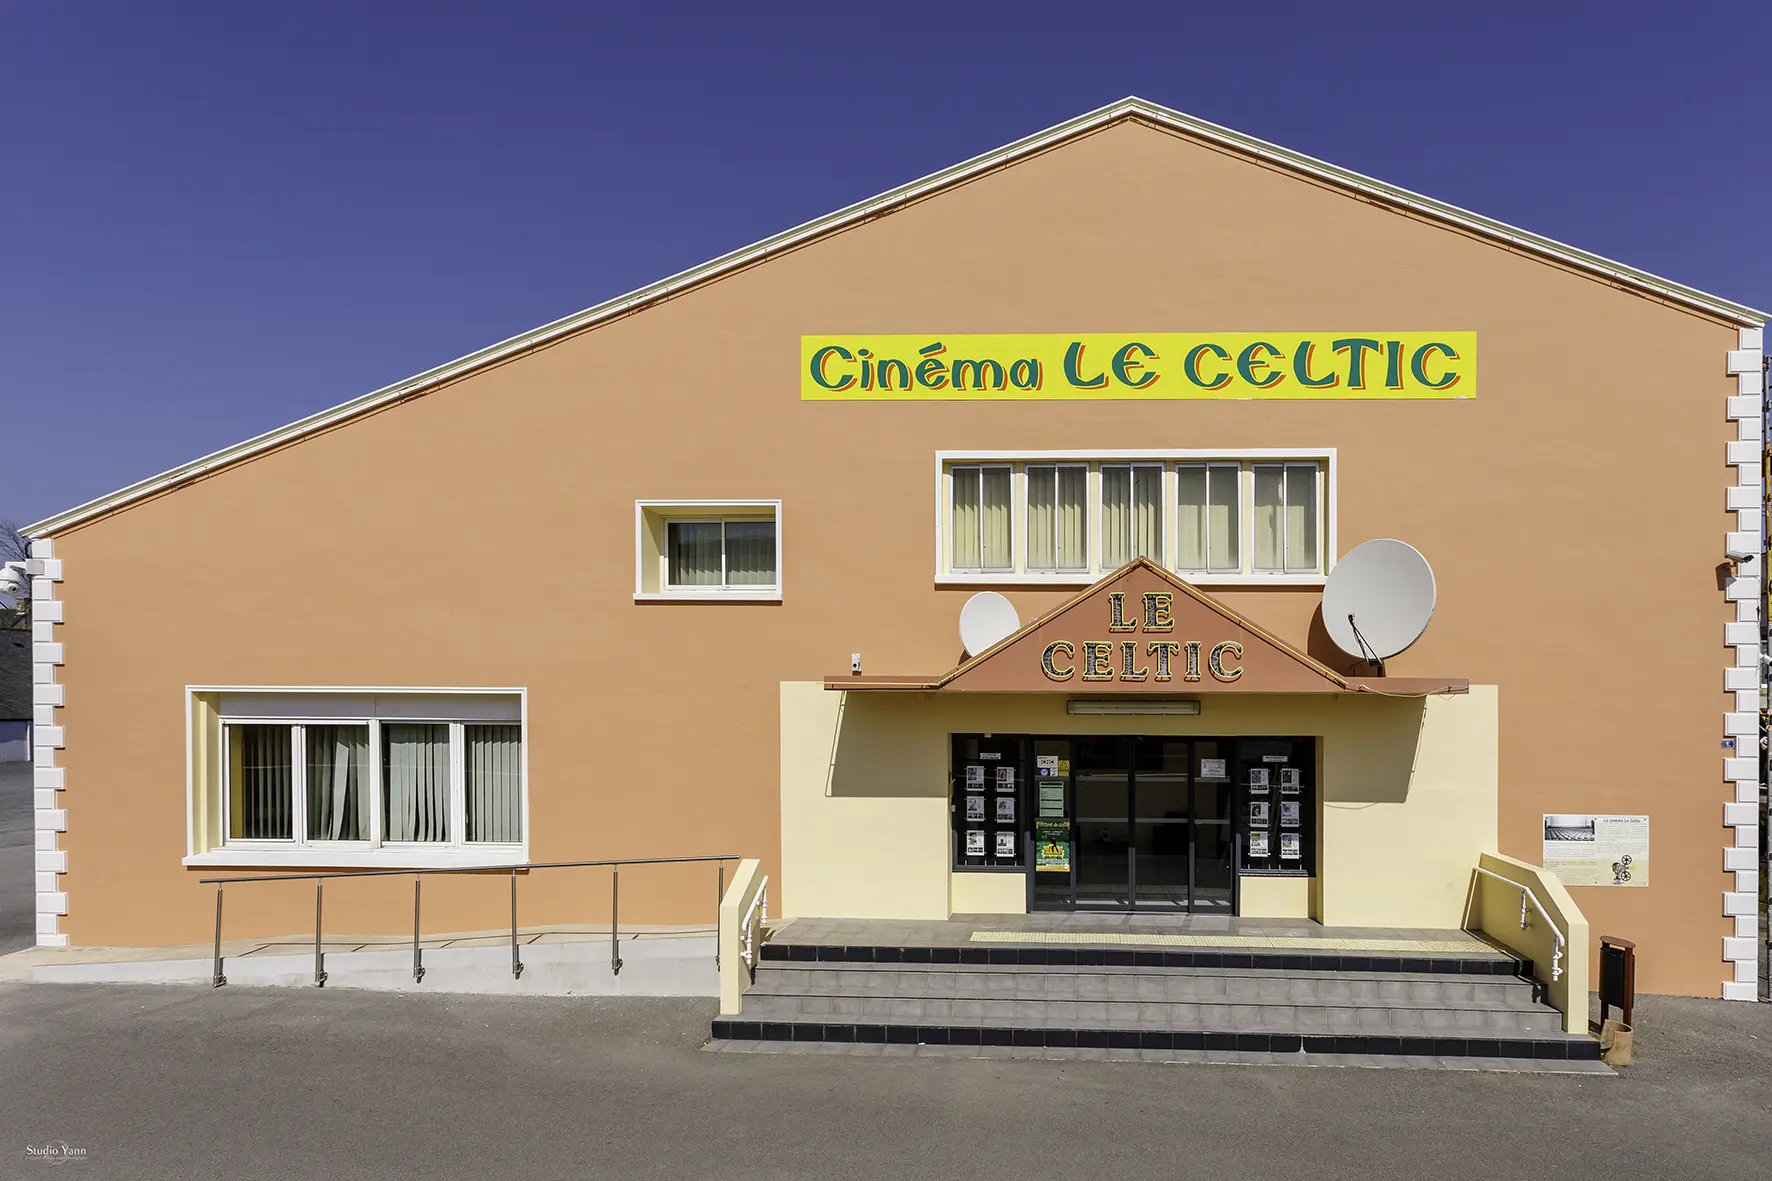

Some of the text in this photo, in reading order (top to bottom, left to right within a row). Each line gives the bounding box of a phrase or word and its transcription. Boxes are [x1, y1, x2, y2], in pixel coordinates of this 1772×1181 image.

[810, 338, 1462, 392] Cinéma LE CELTIC
[1108, 591, 1175, 633] LE
[1041, 640, 1245, 683] CELTIC
